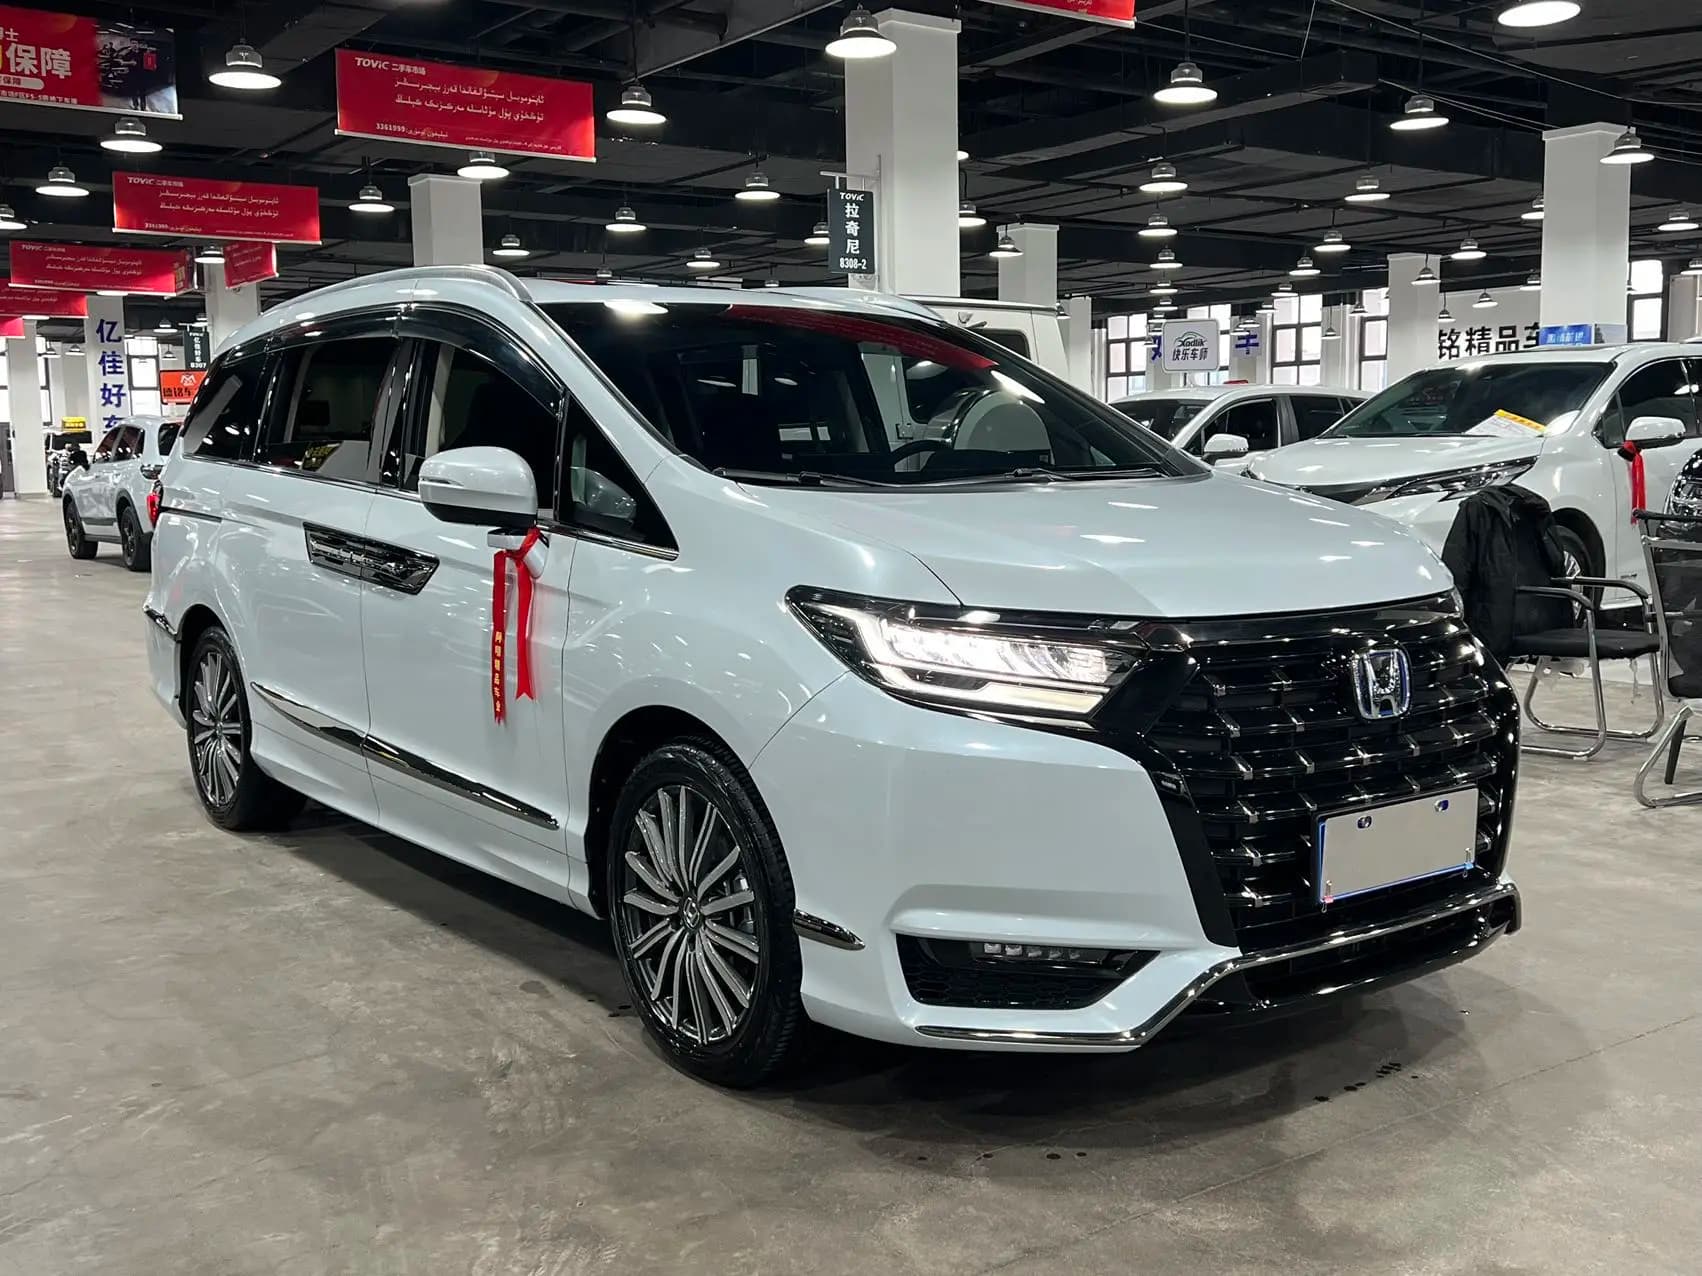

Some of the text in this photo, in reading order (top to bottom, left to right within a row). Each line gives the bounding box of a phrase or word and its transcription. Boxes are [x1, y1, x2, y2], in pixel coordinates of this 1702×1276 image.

[0, 43, 73, 79] 保障
[844, 202, 860, 254] 拉奇尼
[839, 257, 867, 270] 8308-2
